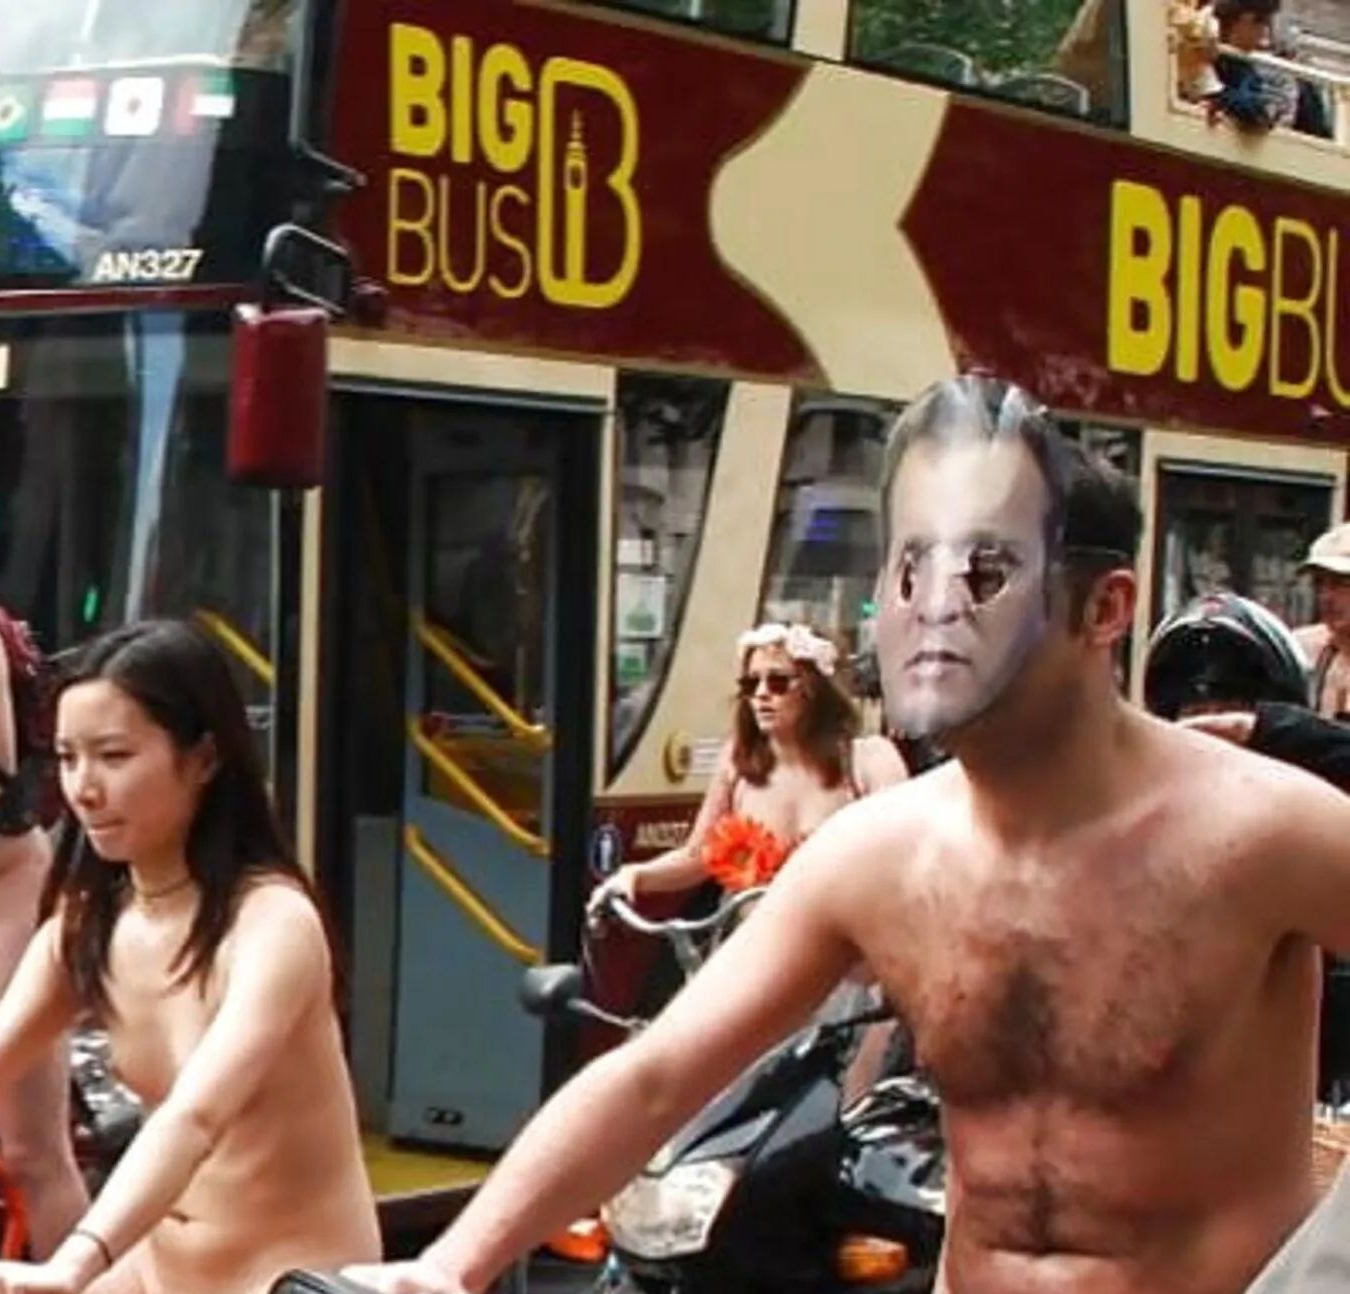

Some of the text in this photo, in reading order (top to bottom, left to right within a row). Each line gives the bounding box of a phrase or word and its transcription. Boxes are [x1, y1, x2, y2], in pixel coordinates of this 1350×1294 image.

[389, 22, 534, 173] BIG
[90, 248, 205, 281] AN327
[388, 167, 533, 298] BUS
